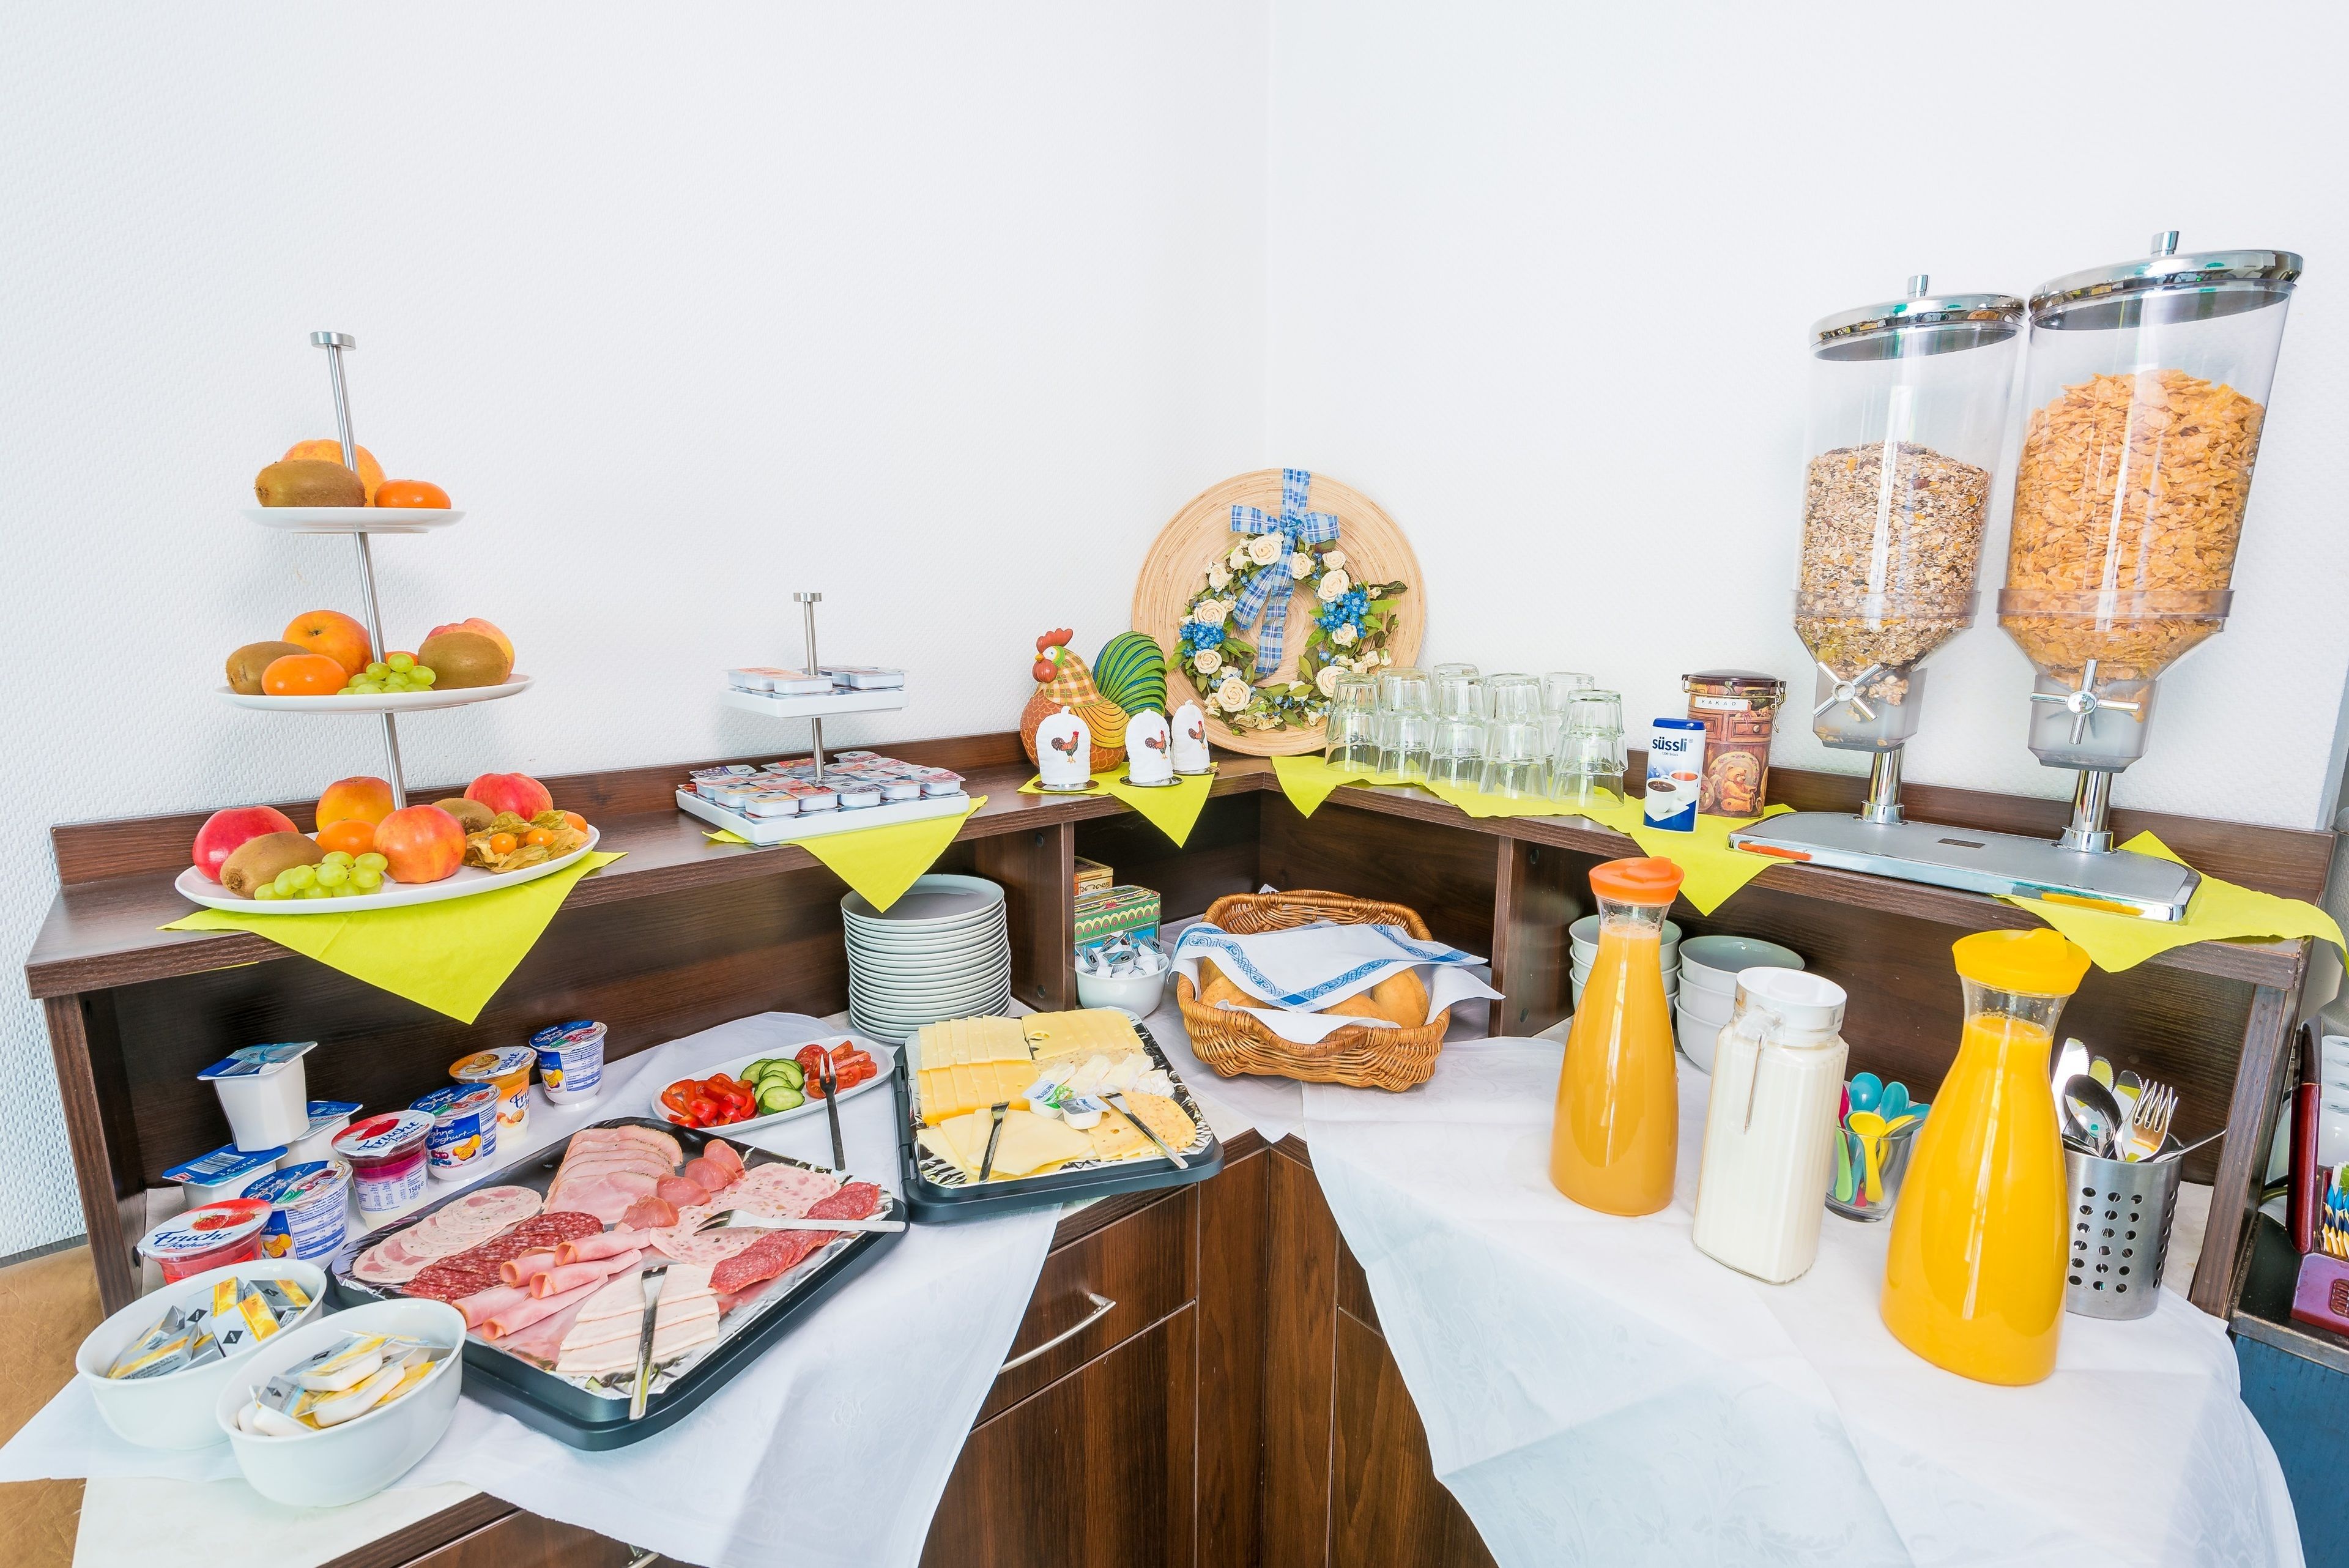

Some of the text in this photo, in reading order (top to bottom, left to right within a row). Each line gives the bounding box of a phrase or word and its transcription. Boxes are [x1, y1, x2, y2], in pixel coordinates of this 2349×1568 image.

[1652, 736, 1688, 752] süssli
[357, 1120, 420, 1151] Frucht
[427, 1131, 467, 1145] Joghurt
[154, 1228, 232, 1246] Frucht
